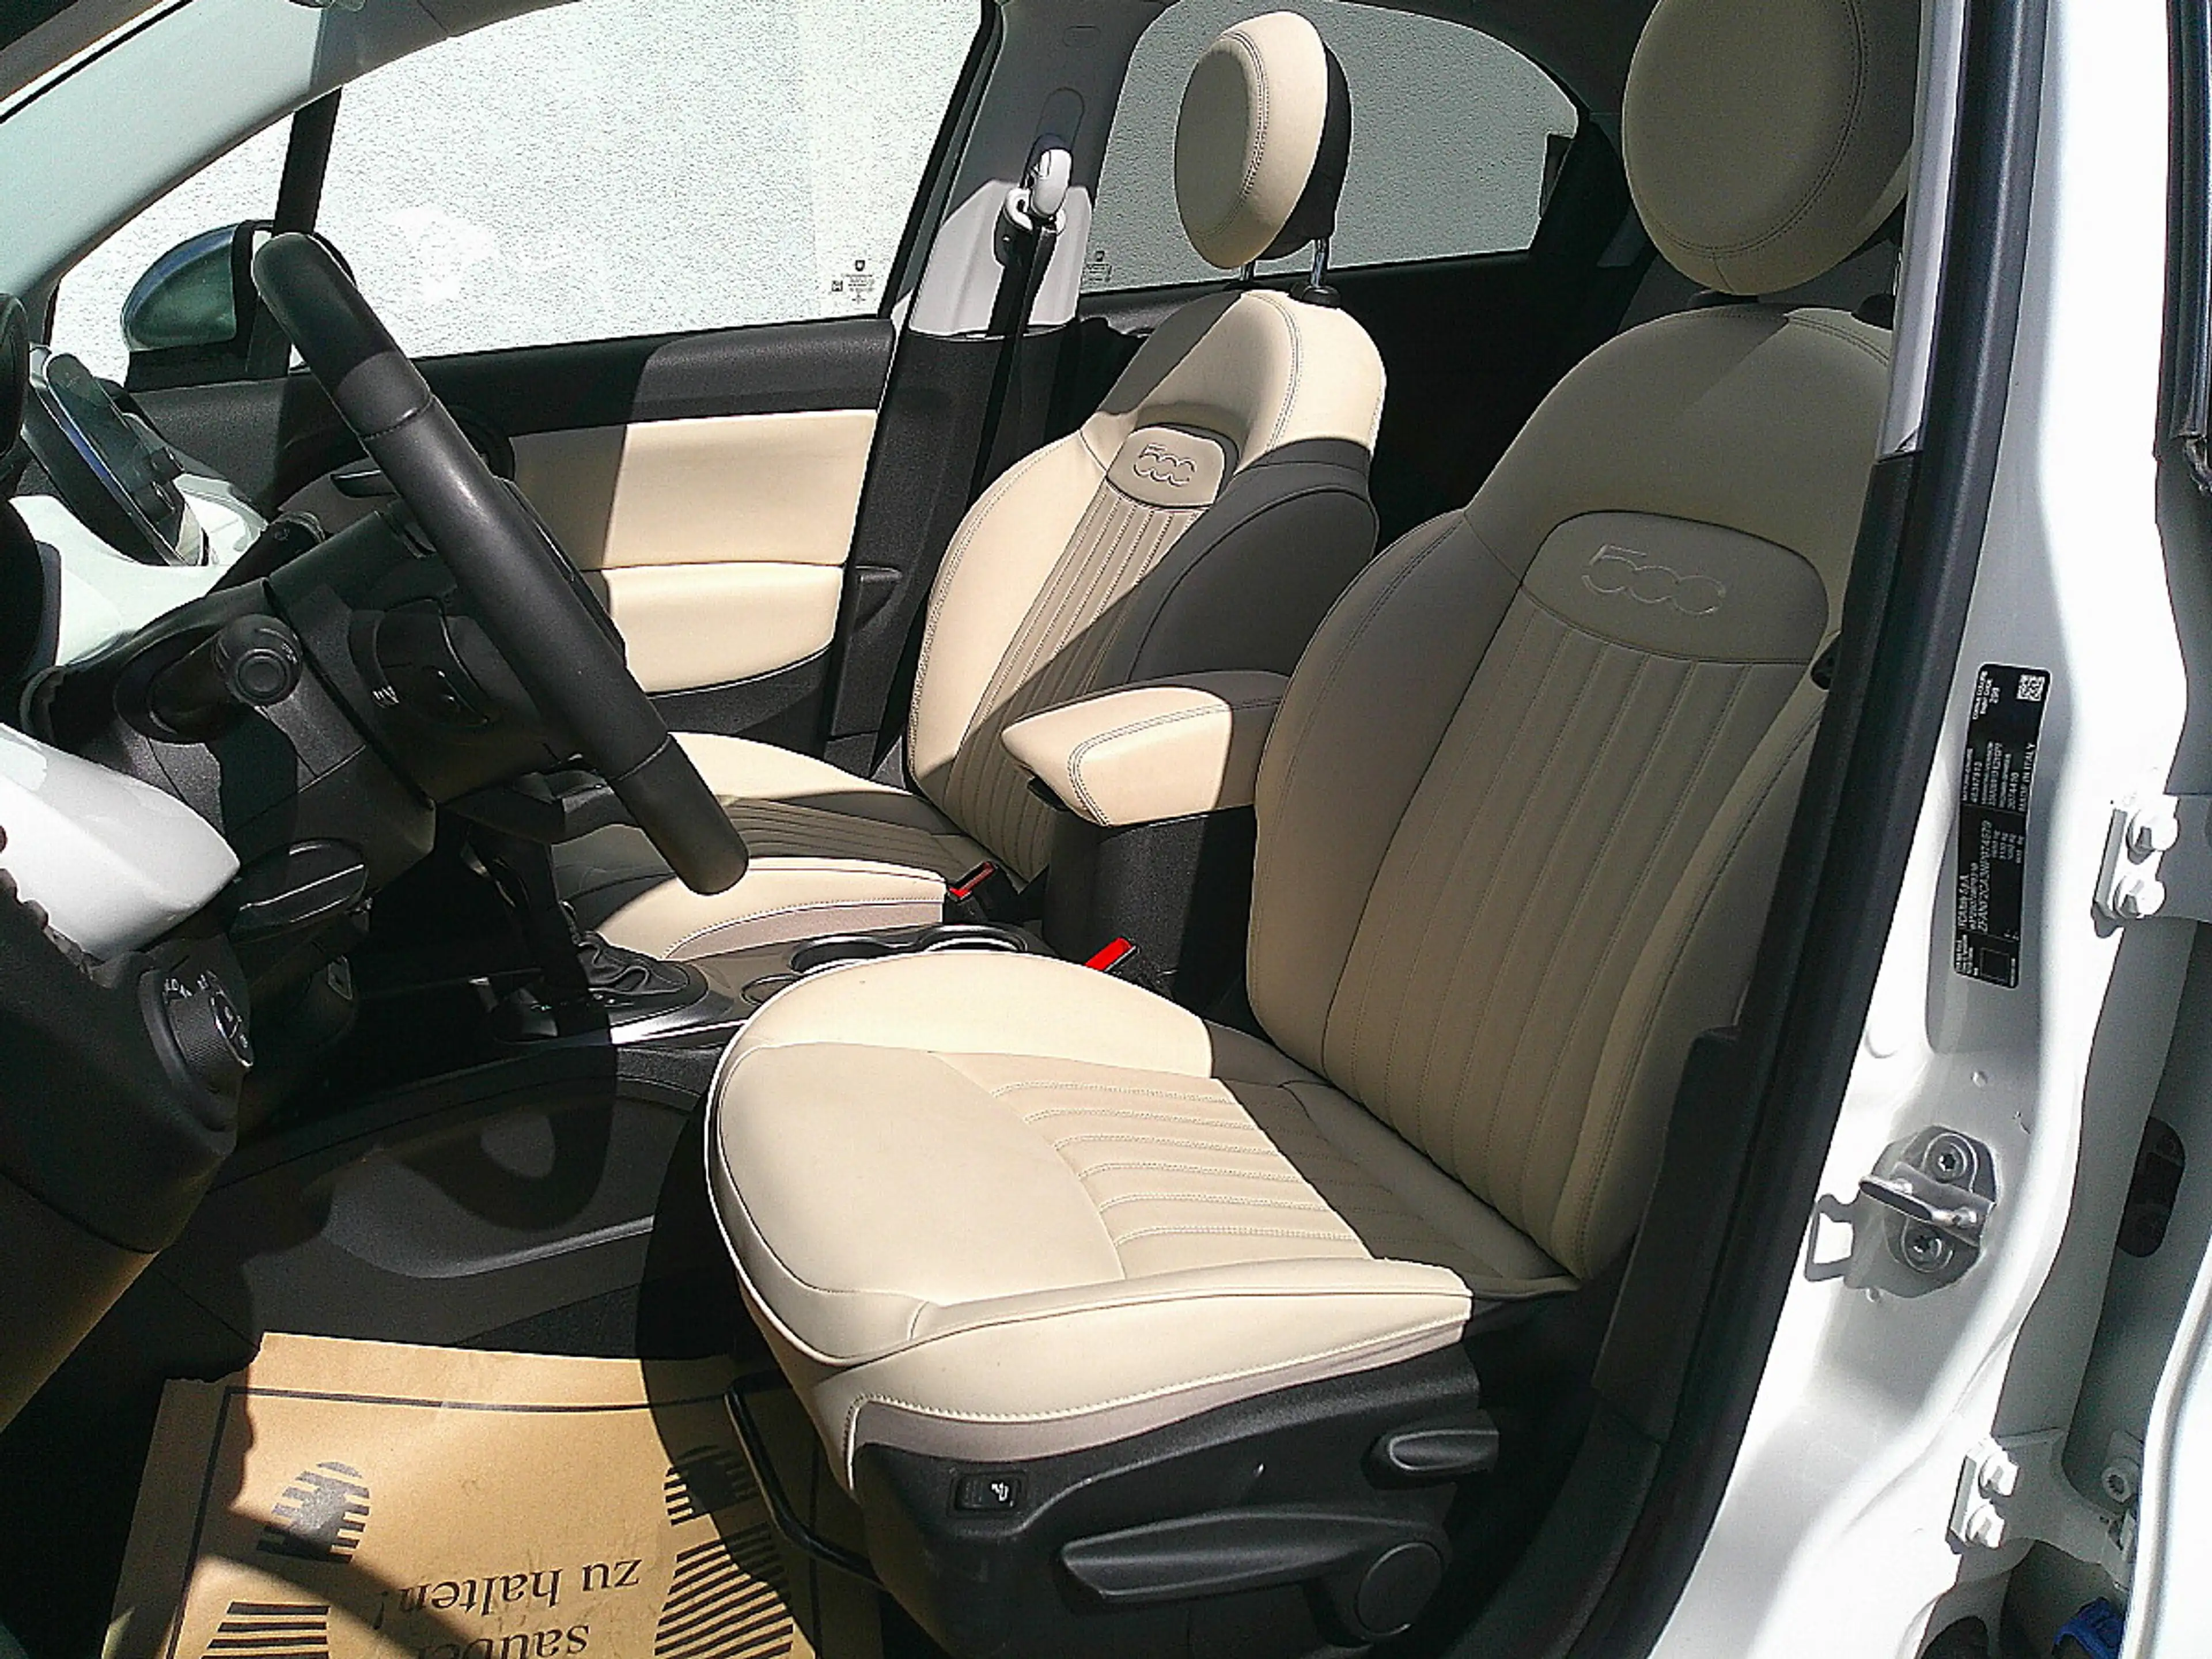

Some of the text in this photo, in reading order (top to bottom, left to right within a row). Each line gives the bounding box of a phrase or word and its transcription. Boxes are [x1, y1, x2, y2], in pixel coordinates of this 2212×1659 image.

[1132, 442, 1198, 487] 500
[1581, 543, 1726, 617] 500
[2022, 742, 2036, 770] ITALY
[372, 1559, 642, 1631] zu halten!
